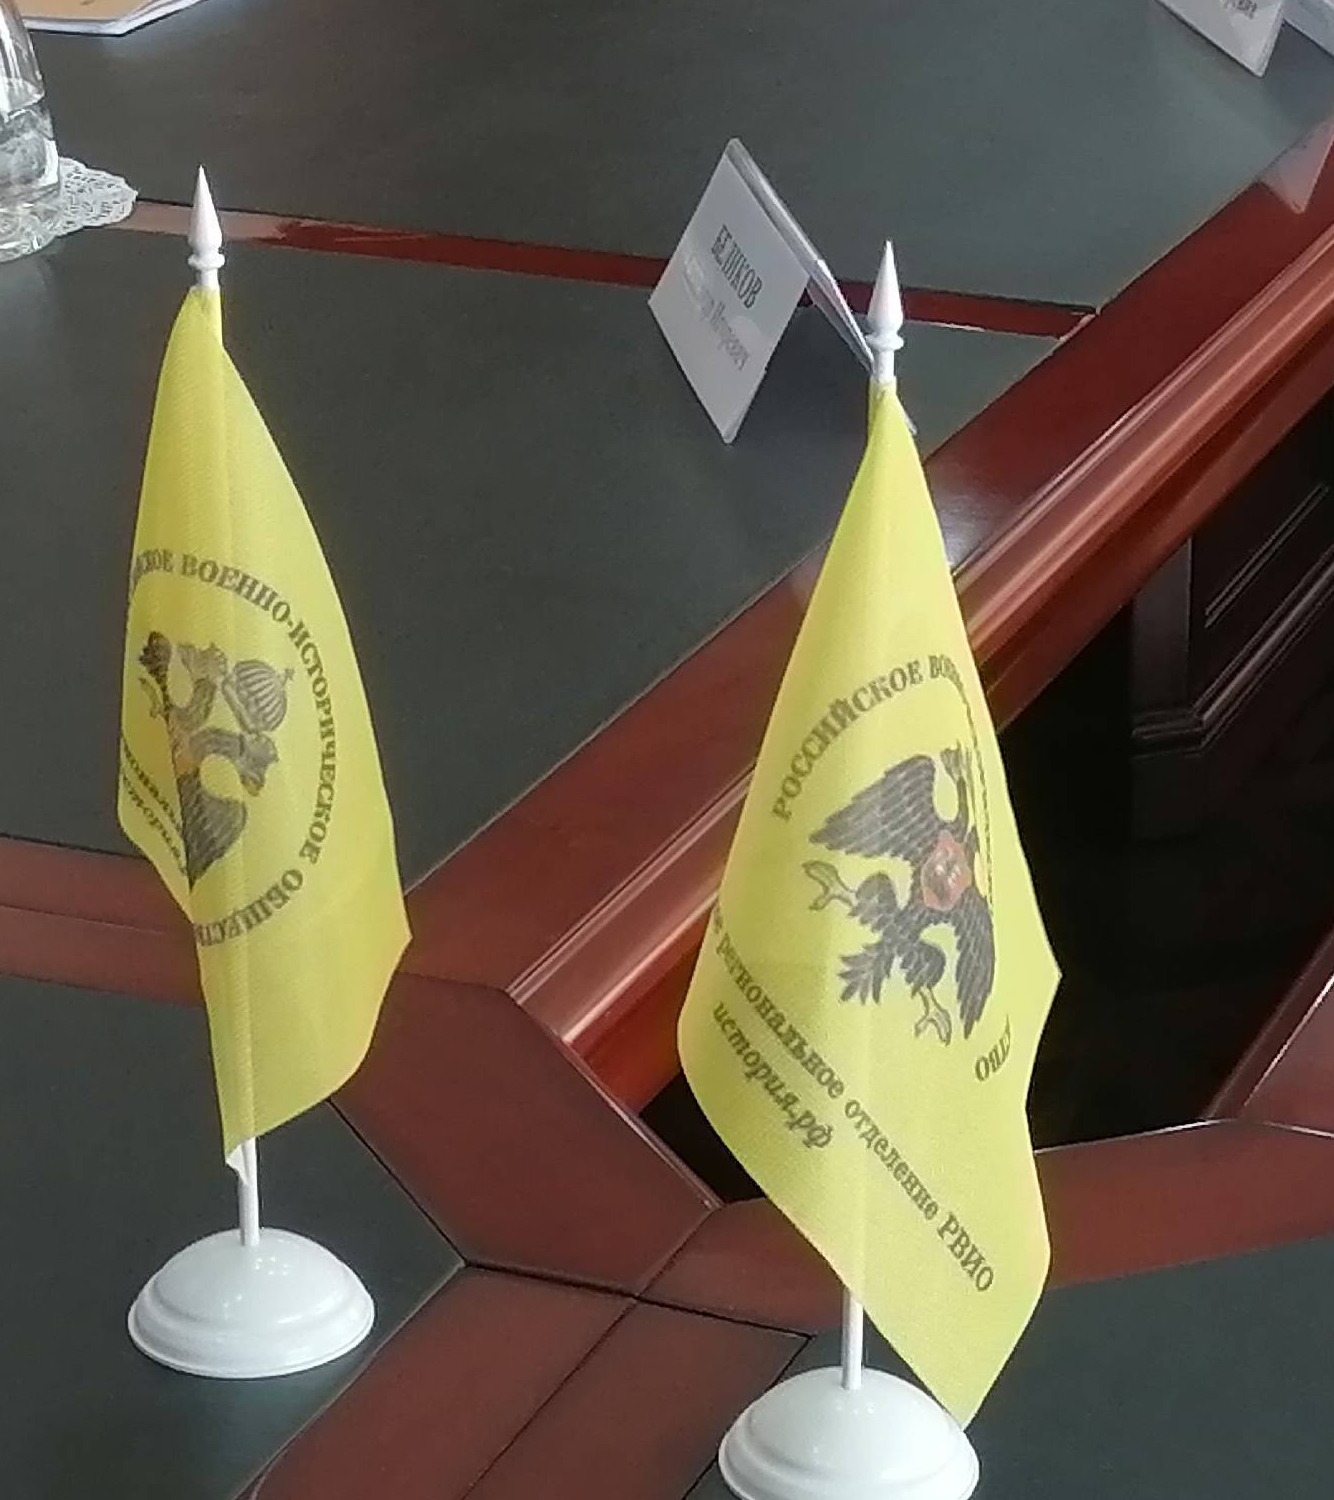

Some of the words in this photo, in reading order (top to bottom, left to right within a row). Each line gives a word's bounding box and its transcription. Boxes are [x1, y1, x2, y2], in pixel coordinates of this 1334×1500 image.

[772, 660, 924, 821] РОССИЙСКОЕ
[713, 1002, 834, 1148] история.рф
[717, 932, 844, 1098] региональное
[844, 1100, 940, 1220] отделение
[937, 1211, 994, 1292] РВИО
